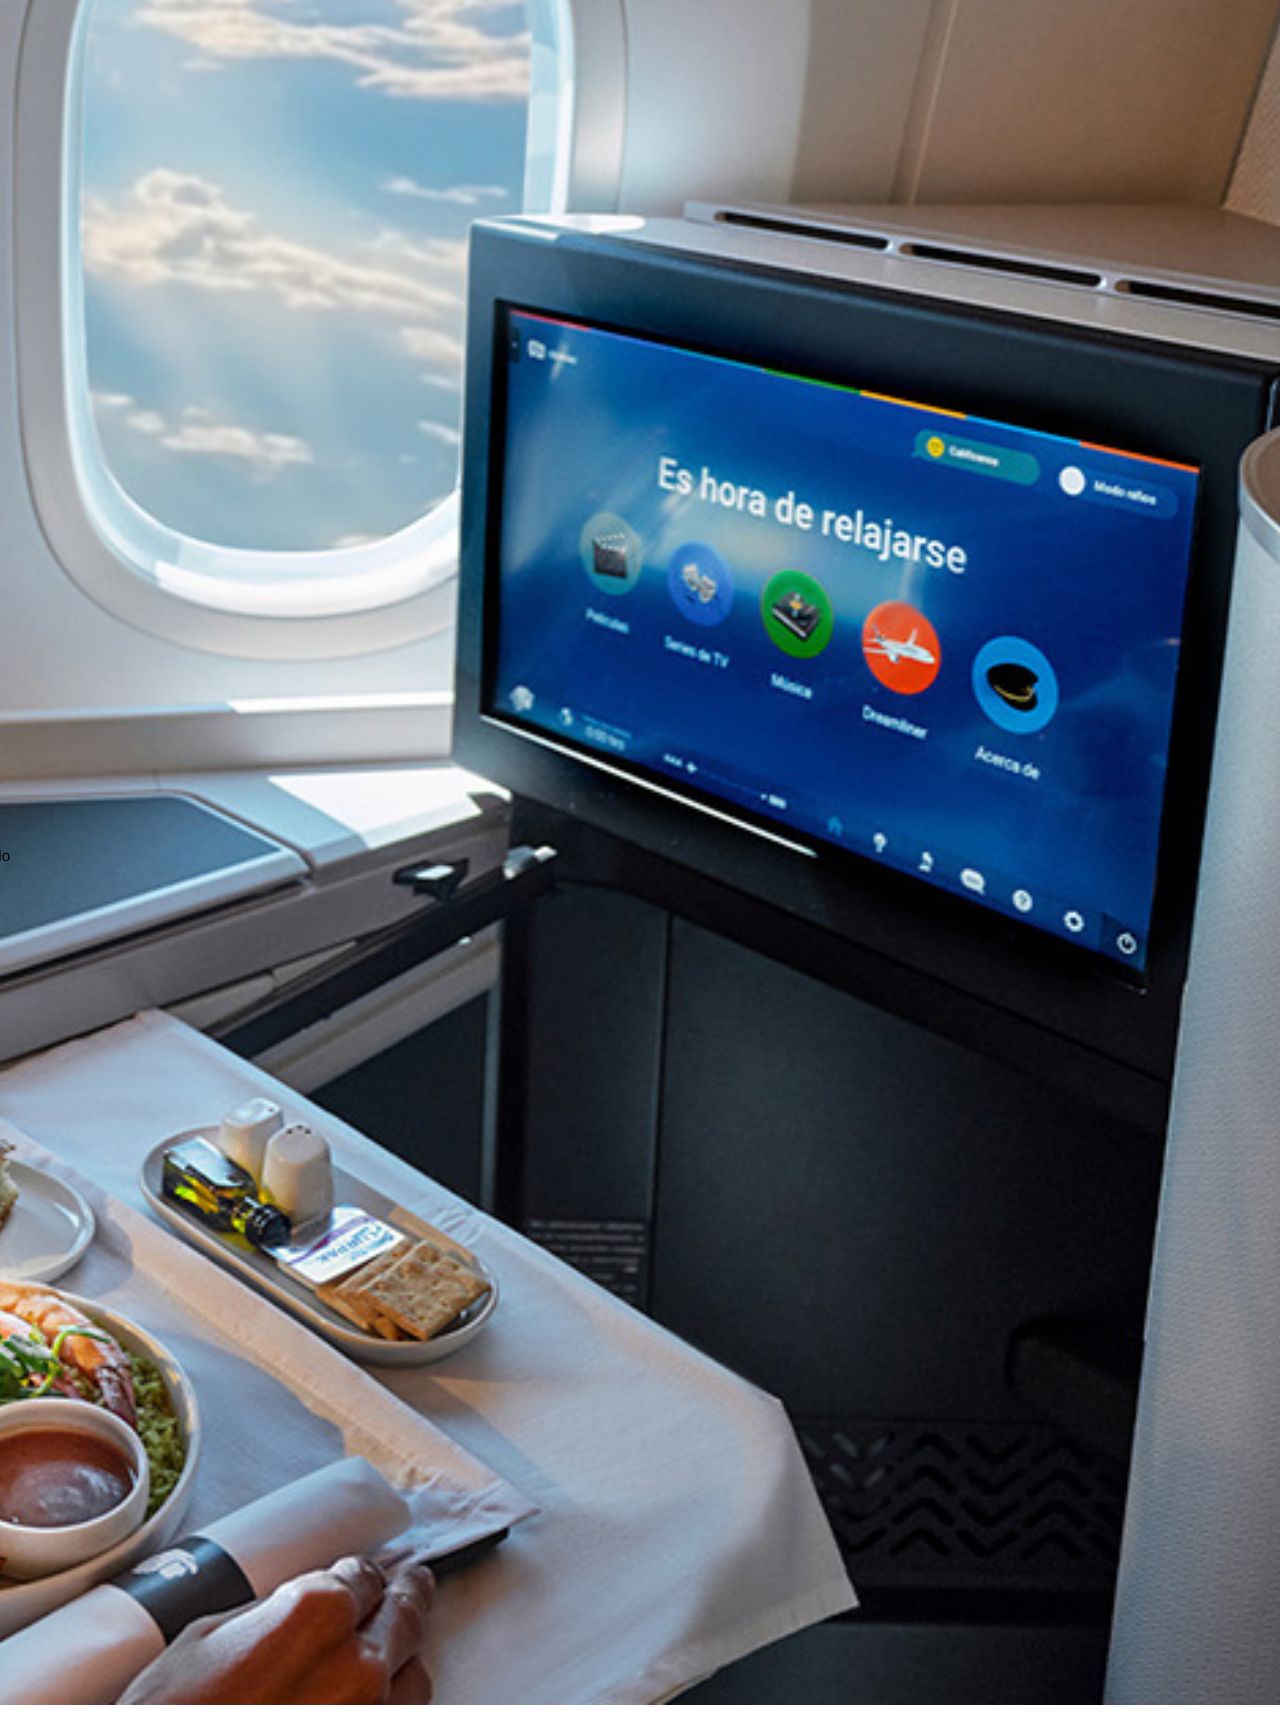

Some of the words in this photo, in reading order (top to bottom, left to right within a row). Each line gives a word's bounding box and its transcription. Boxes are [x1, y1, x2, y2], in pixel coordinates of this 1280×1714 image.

[658, 457, 693, 496] Es
[699, 466, 767, 517] hora
[774, 491, 815, 530] de
[821, 509, 968, 574] relajarse
[714, 652, 730, 668] TV
[974, 745, 1020, 774] Acerca
[1022, 762, 1041, 781] de
